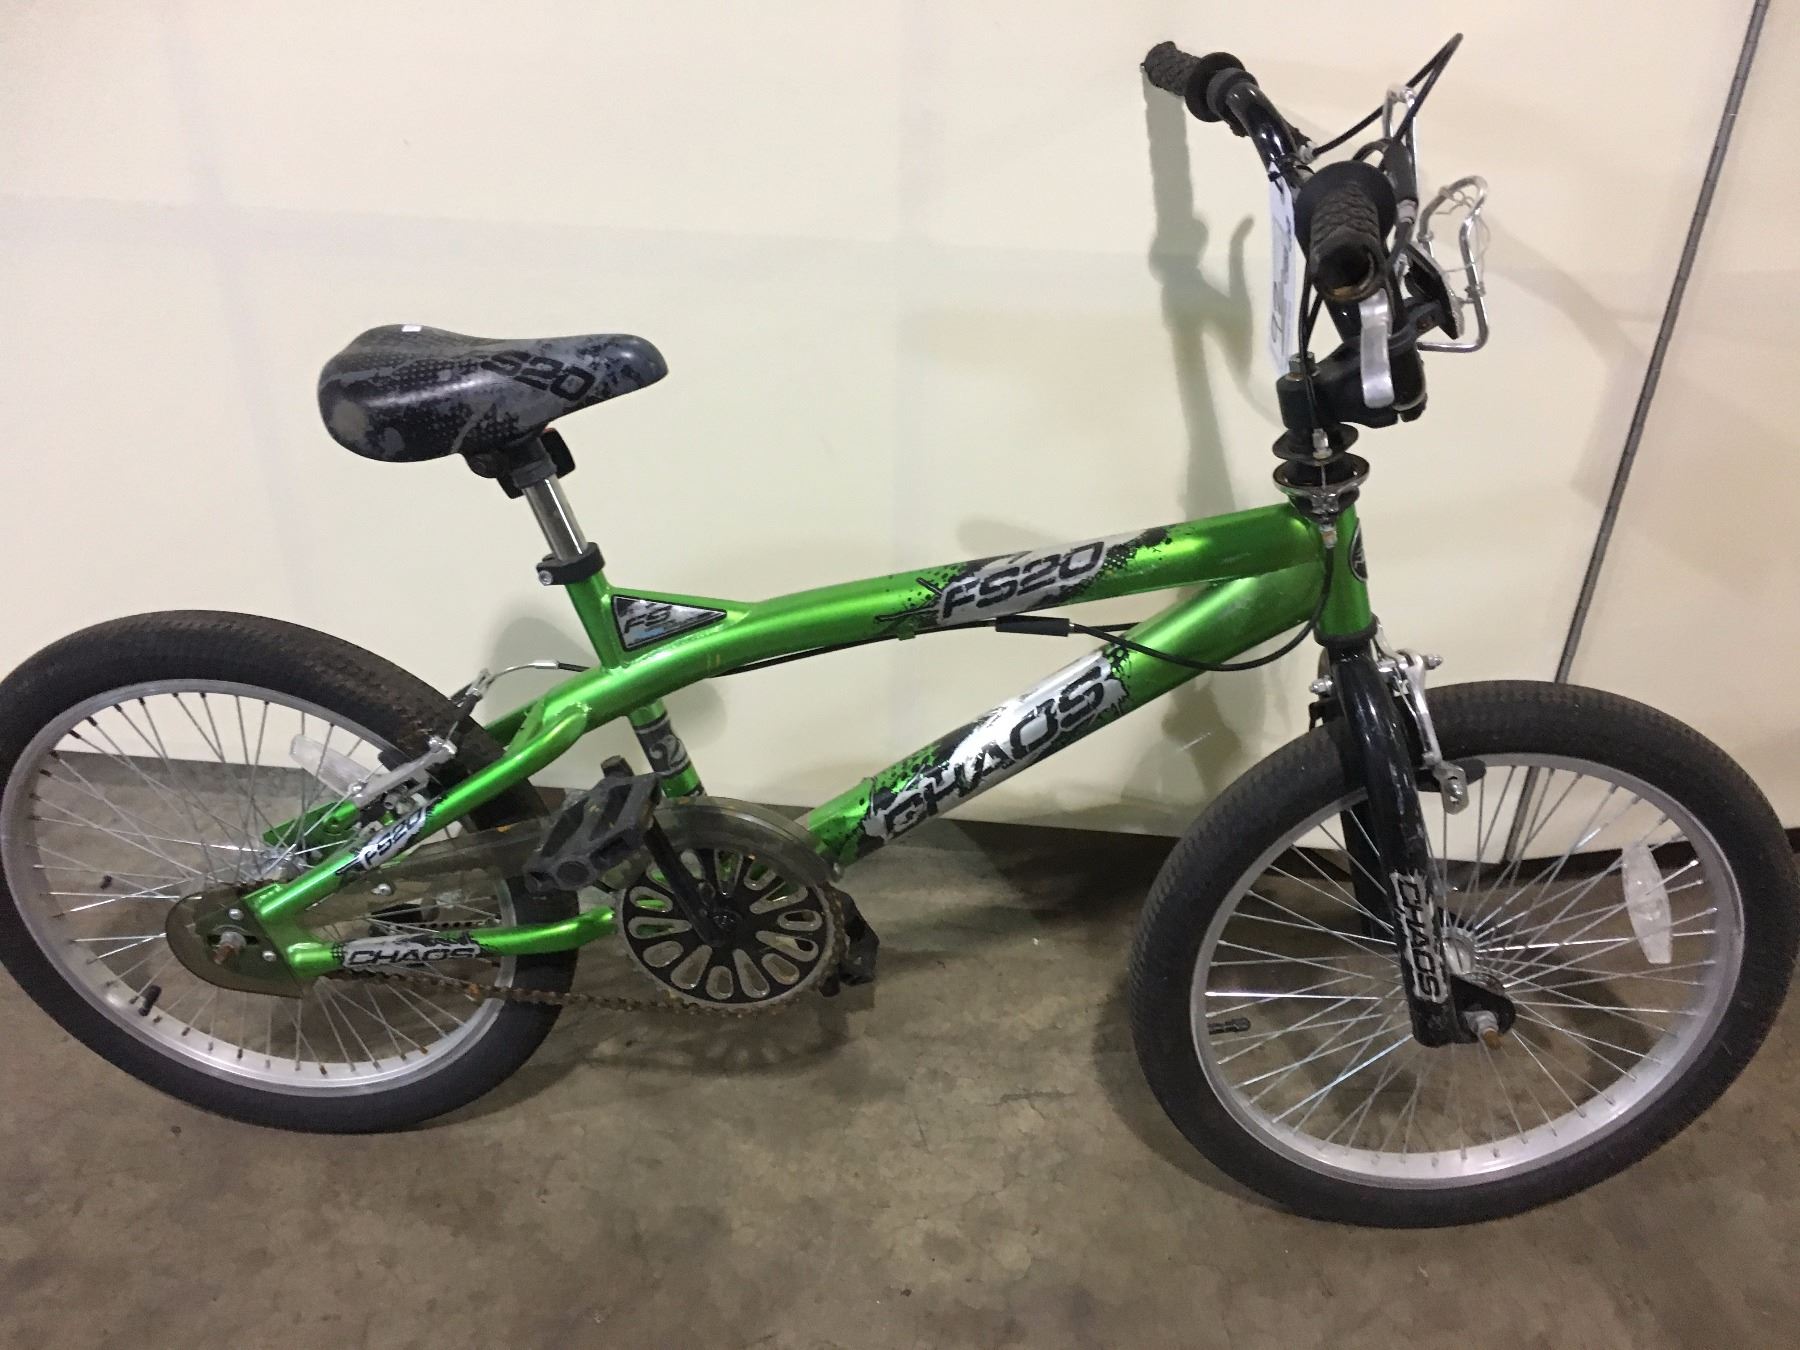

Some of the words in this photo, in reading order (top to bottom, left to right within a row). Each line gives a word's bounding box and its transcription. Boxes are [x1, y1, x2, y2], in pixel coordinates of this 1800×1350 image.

[942, 541, 1104, 619] FS20
[623, 604, 673, 634] FS
[884, 665, 1105, 840] CHAOS
[364, 808, 423, 867] FS20
[349, 947, 477, 966] CHAOS
[1398, 878, 1441, 997] CHAOS
